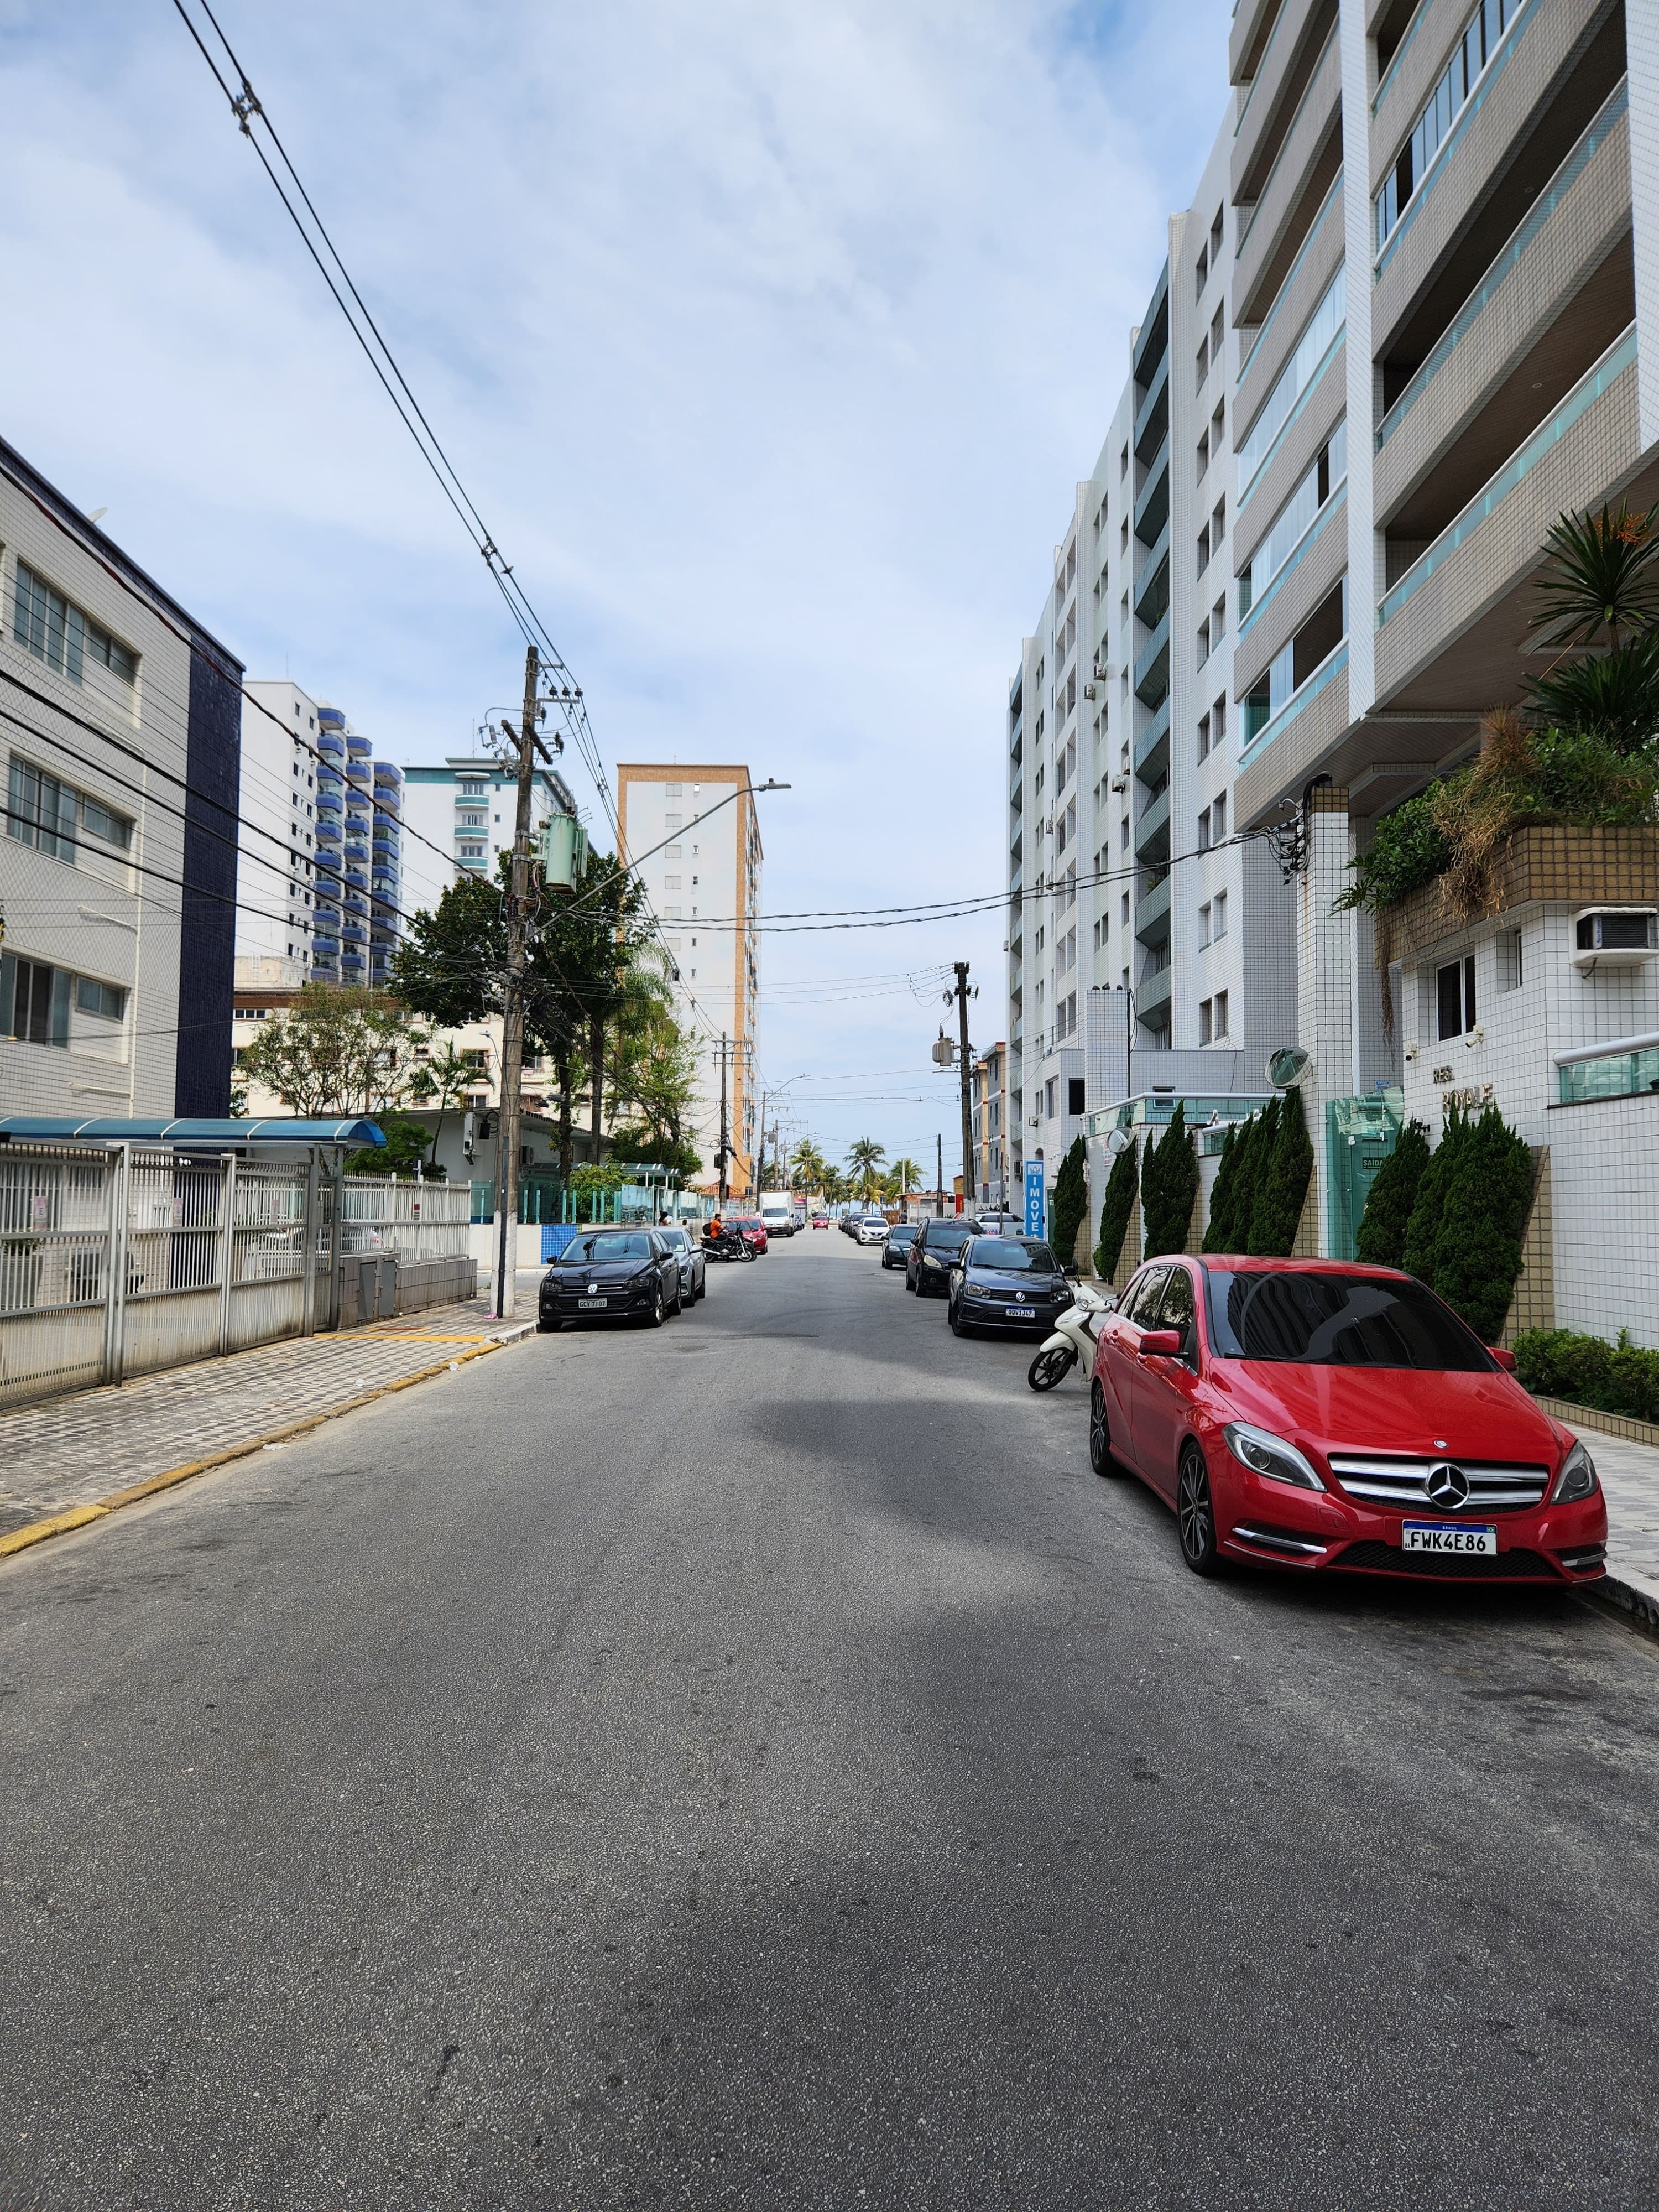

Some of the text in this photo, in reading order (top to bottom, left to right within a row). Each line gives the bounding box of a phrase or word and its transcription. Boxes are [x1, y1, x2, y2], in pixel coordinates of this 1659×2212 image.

[1442, 1084, 1493, 1113] ROYALE
[1030, 1176, 1040, 1237] IMÓVE
[1411, 1531, 1486, 1552] FWK4E86
